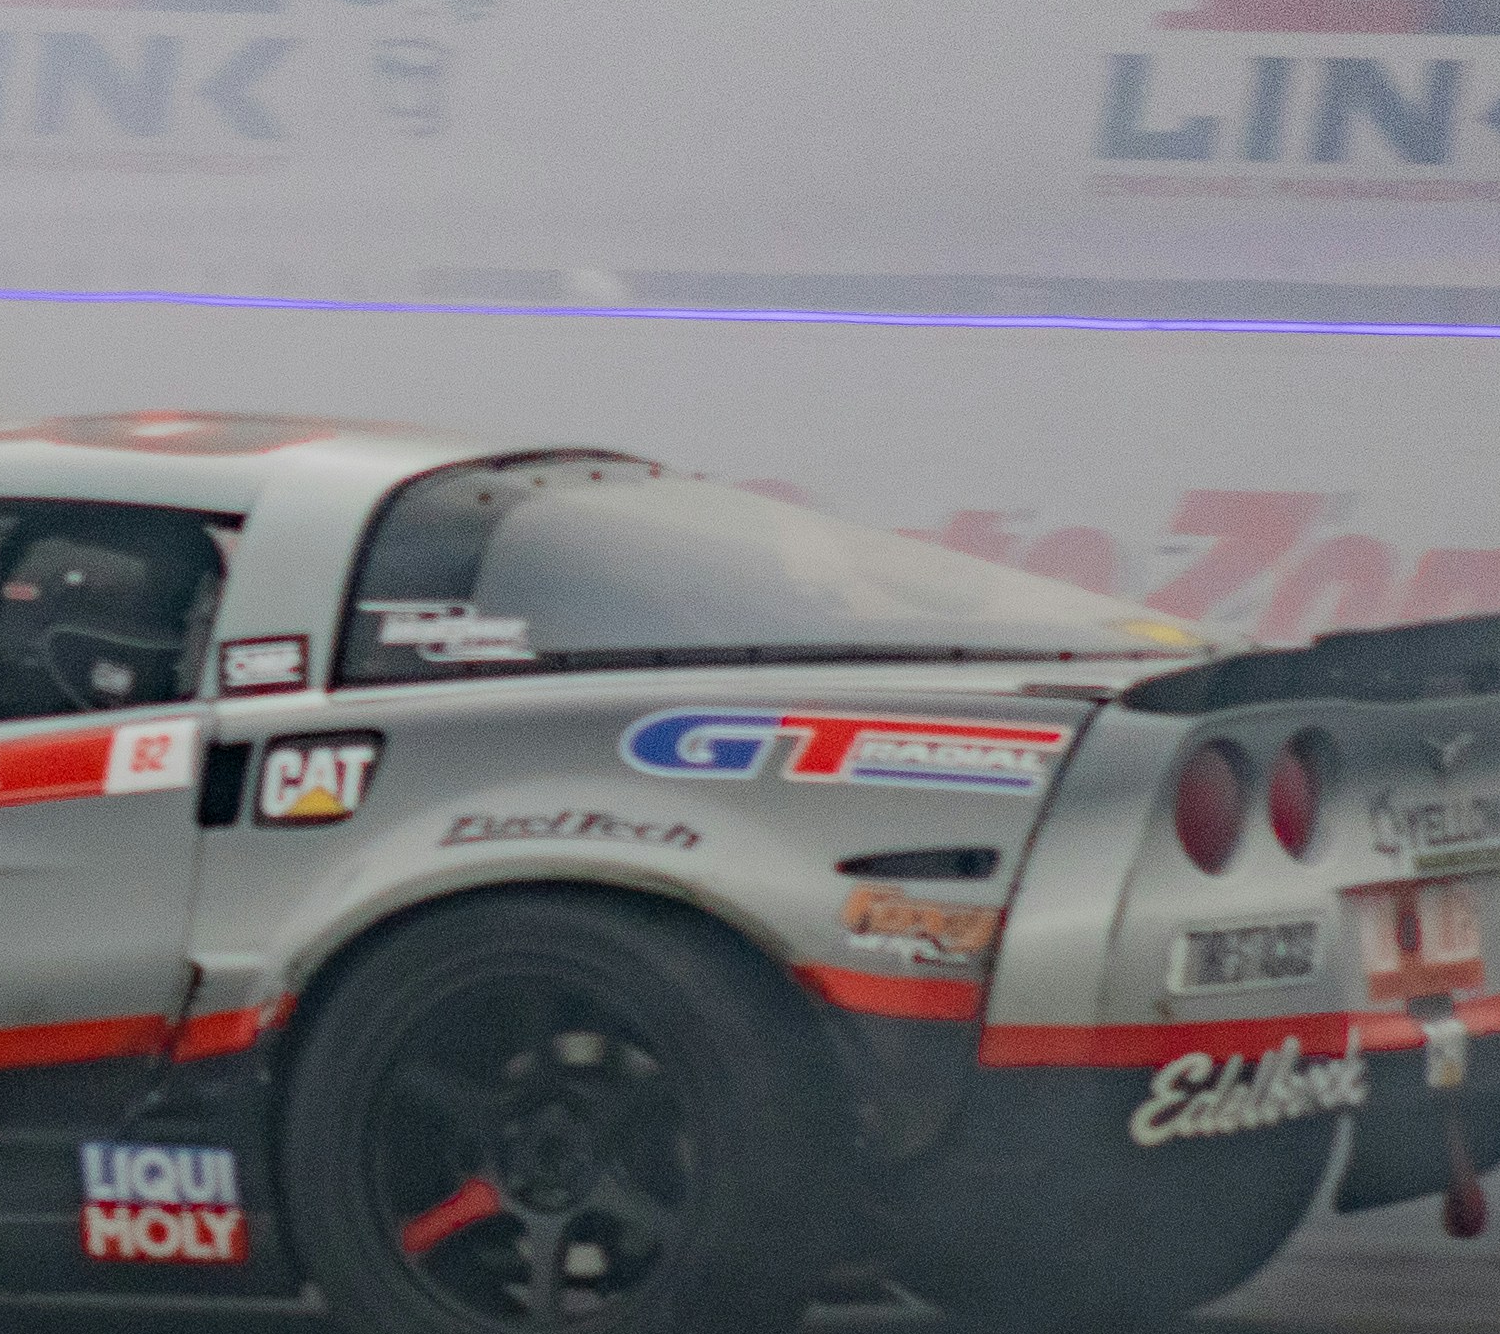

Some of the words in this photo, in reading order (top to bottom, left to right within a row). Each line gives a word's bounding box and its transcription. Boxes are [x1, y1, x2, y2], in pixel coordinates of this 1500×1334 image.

[261, 745, 376, 820] CAT
[81, 1143, 236, 1205] LIQUI
[86, 1205, 243, 1260] MOLY
